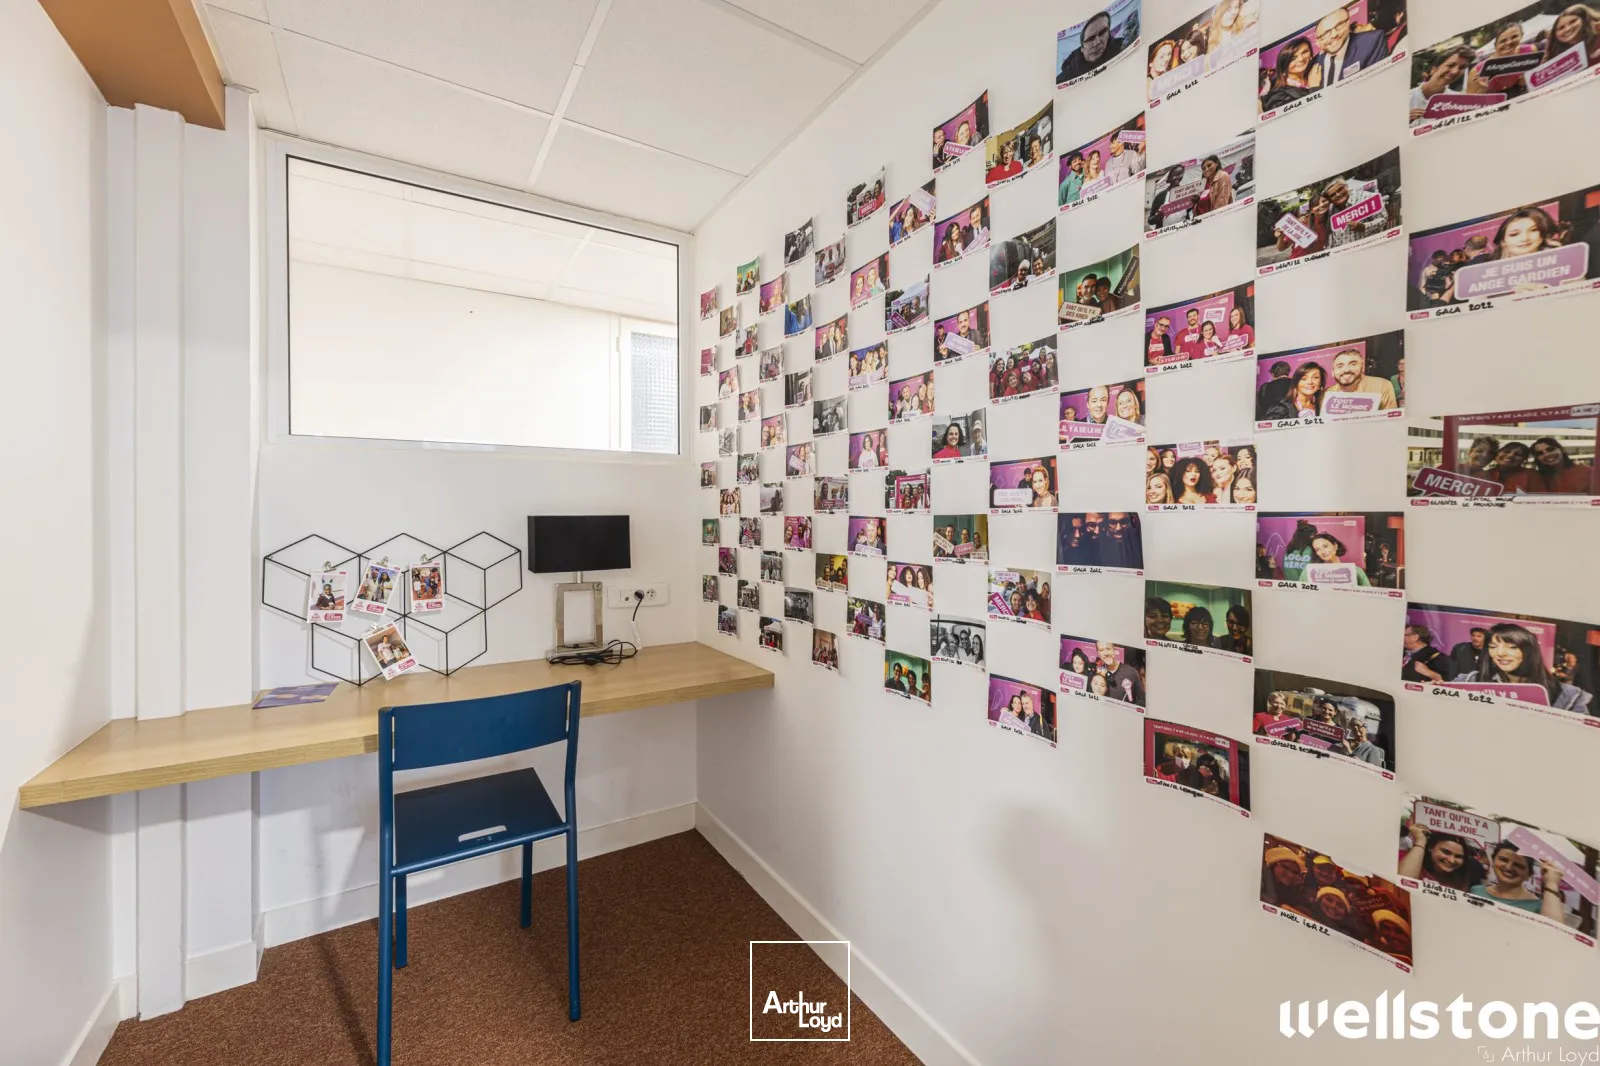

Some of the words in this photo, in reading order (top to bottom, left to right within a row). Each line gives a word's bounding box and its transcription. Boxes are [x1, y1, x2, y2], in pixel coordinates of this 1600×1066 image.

[1336, 204, 1369, 226] MERCI
[1482, 267, 1500, 279] JE
[1501, 260, 1534, 276] SUIS
[1537, 254, 1557, 268] UN
[1468, 278, 1505, 294] ANGE
[1508, 265, 1571, 286] GARDIEN
[1436, 306, 1461, 316] GALA
[1468, 302, 1494, 312] 2022
[1277, 418, 1300, 428] GALA
[1424, 473, 1480, 496] MERCI
[1432, 688, 1460, 698] GALA
[1468, 694, 1495, 704] 2022
[1424, 806, 1448, 820] TANT
[1449, 812, 1472, 826] QU'IL
[1474, 818, 1482, 828] Y
[1482, 822, 1489, 830] A
[1430, 817, 1442, 828] DE
[1444, 820, 1456, 830] LA
